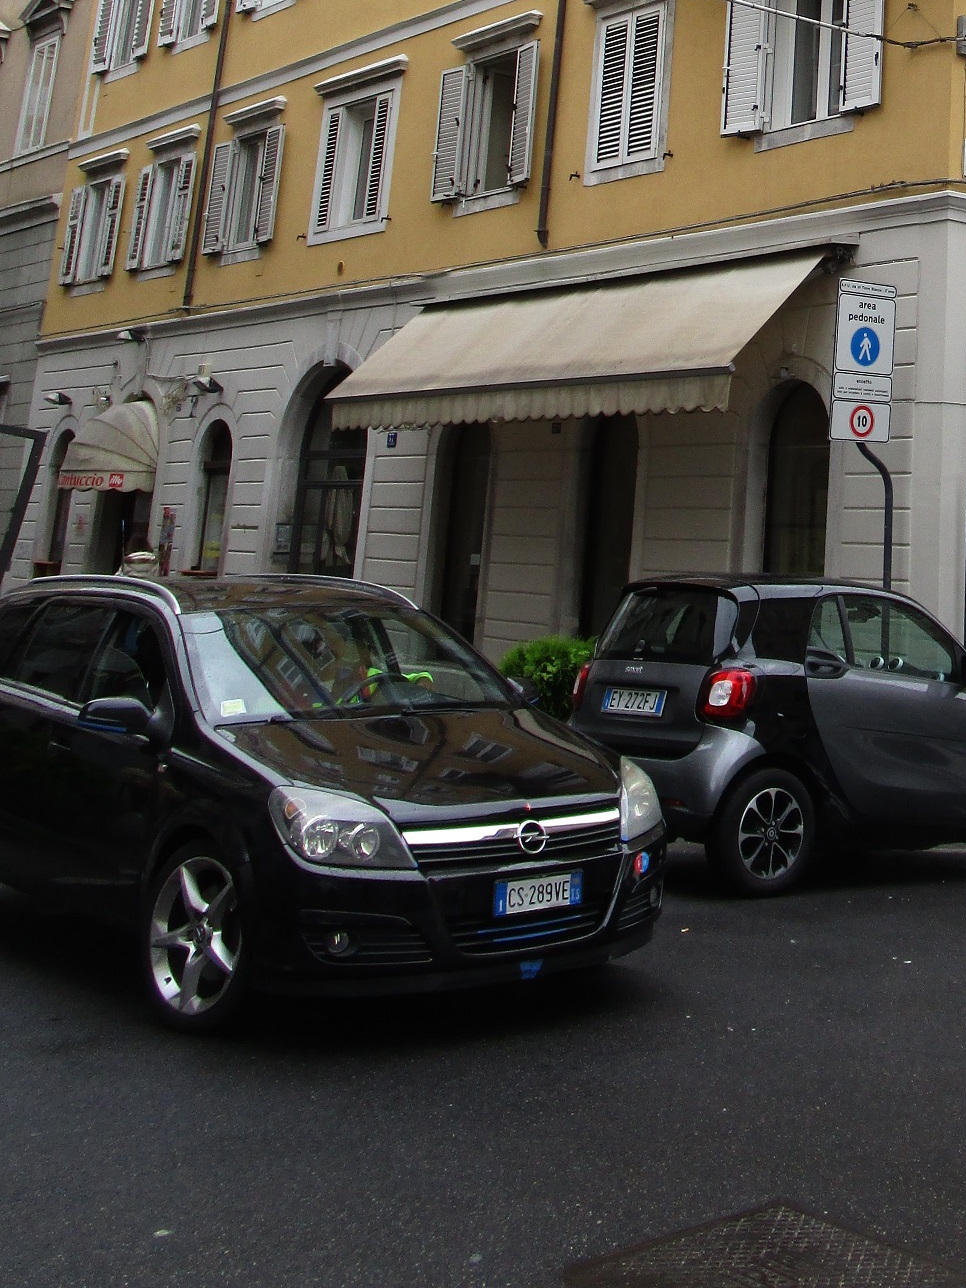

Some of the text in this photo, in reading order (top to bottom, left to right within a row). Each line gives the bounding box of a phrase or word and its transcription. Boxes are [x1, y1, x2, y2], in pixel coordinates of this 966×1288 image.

[859, 302, 876, 310] area
[848, 313, 885, 324] pedonale
[857, 415, 867, 427] 10
[110, 475, 123, 486] illy
[610, 691, 624, 707] EY
[625, 692, 658, 710] 272FJ
[508, 887, 524, 908] CS
[529, 880, 570, 905] 289VE
